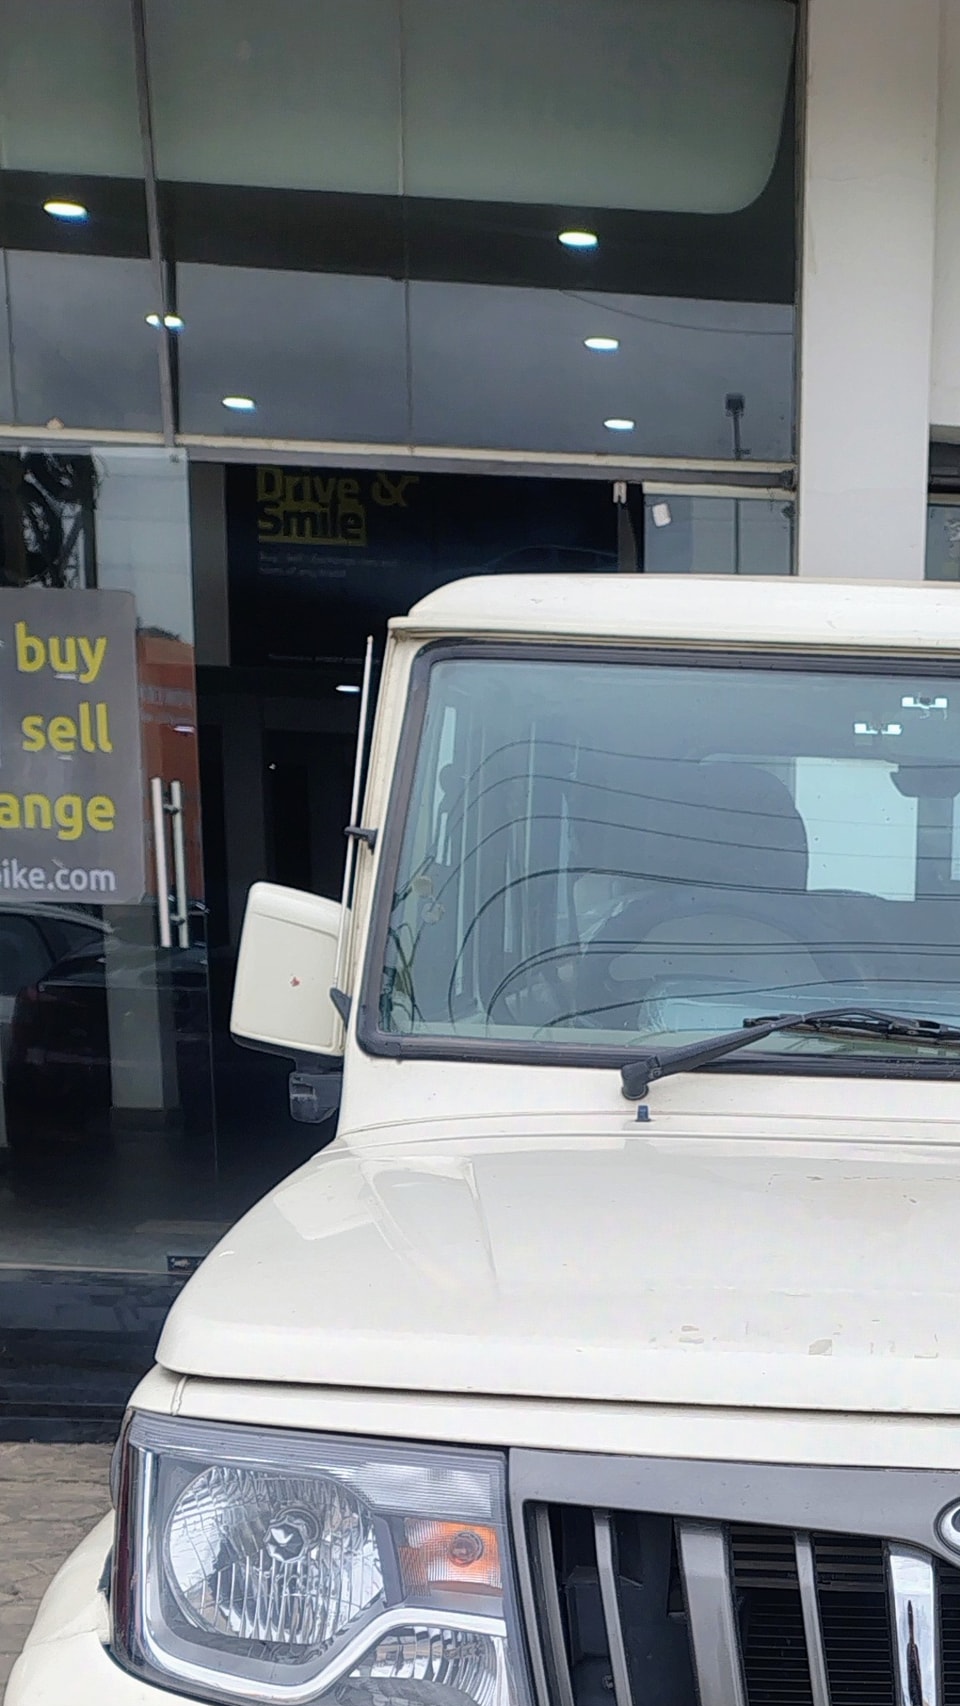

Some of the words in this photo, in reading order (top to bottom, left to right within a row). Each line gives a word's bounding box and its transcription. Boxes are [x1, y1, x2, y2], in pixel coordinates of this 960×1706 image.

[257, 465, 361, 503] Drive
[257, 500, 364, 541] Smile
[15, 621, 107, 684] buy
[21, 701, 113, 753] sell
[0, 858, 117, 892] ike.com
